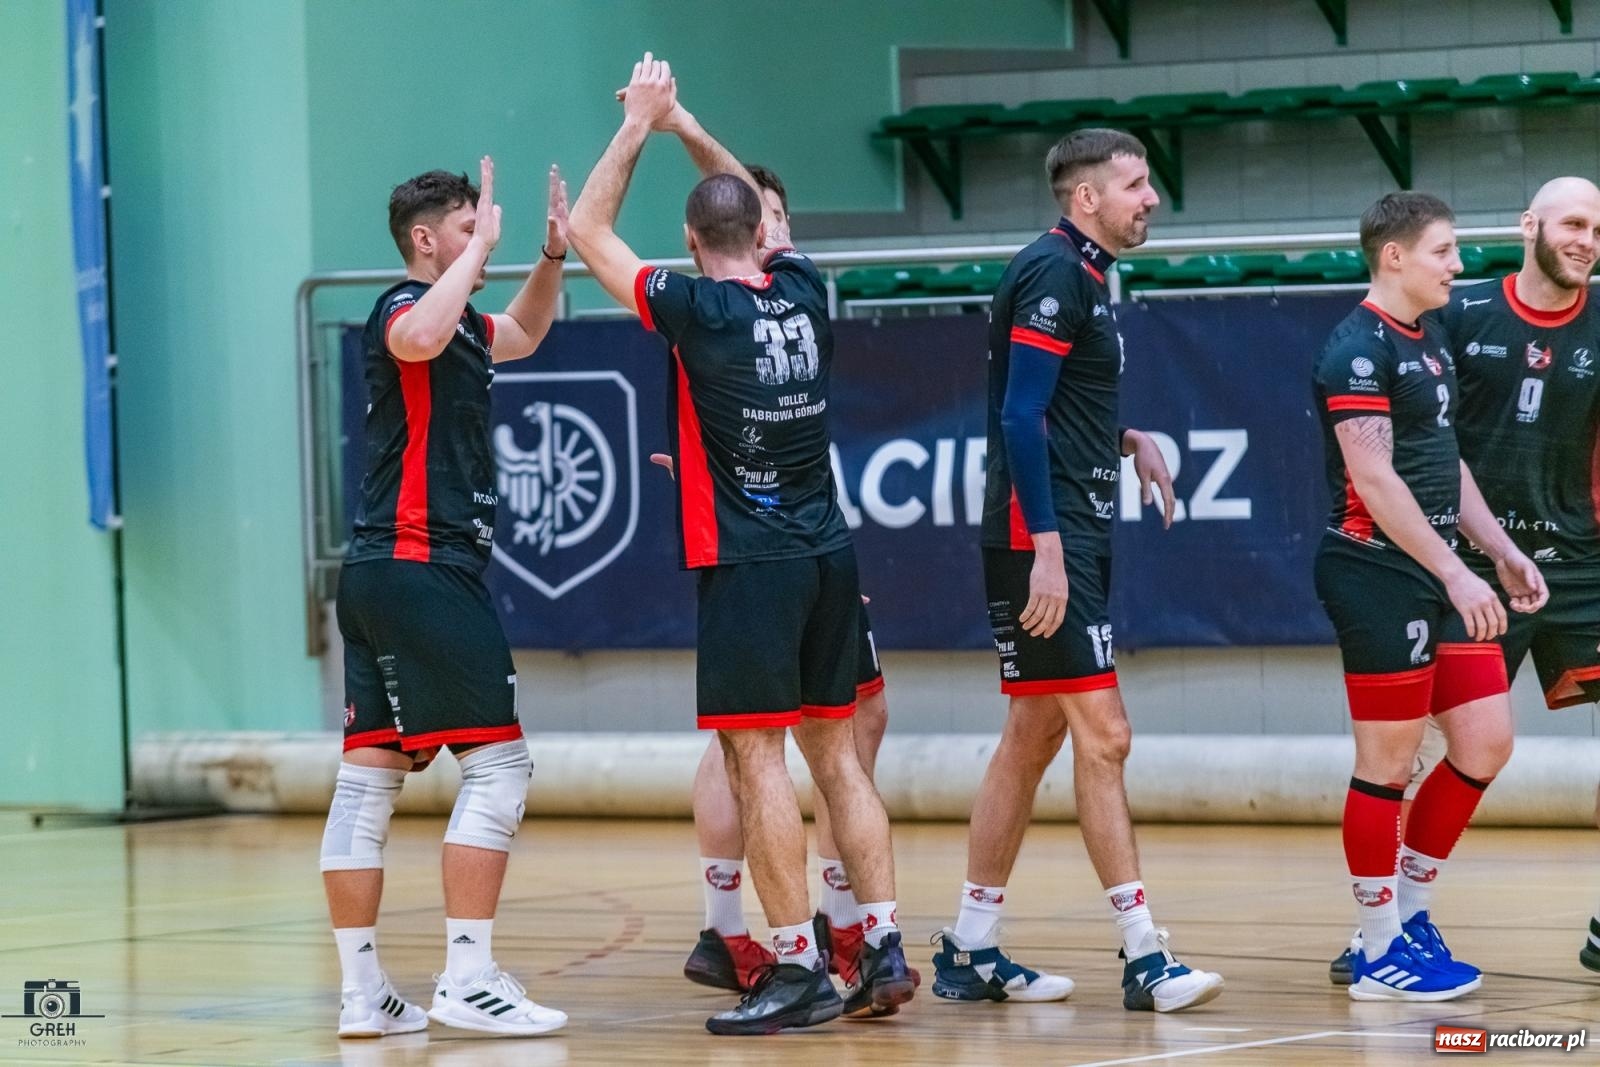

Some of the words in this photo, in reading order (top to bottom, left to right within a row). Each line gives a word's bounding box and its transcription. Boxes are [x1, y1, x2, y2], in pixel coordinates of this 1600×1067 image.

[753, 313, 819, 385] 33
[742, 407, 794, 422] DĄBROWA
[778, 392, 809, 408] VOLLEY
[1436, 383, 1450, 427] 2
[1517, 377, 1545, 422] 9
[745, 471, 762, 483] PHU
[763, 470, 778, 483] AIP
[1086, 624, 1116, 669] 12
[1406, 619, 1431, 665] 2
